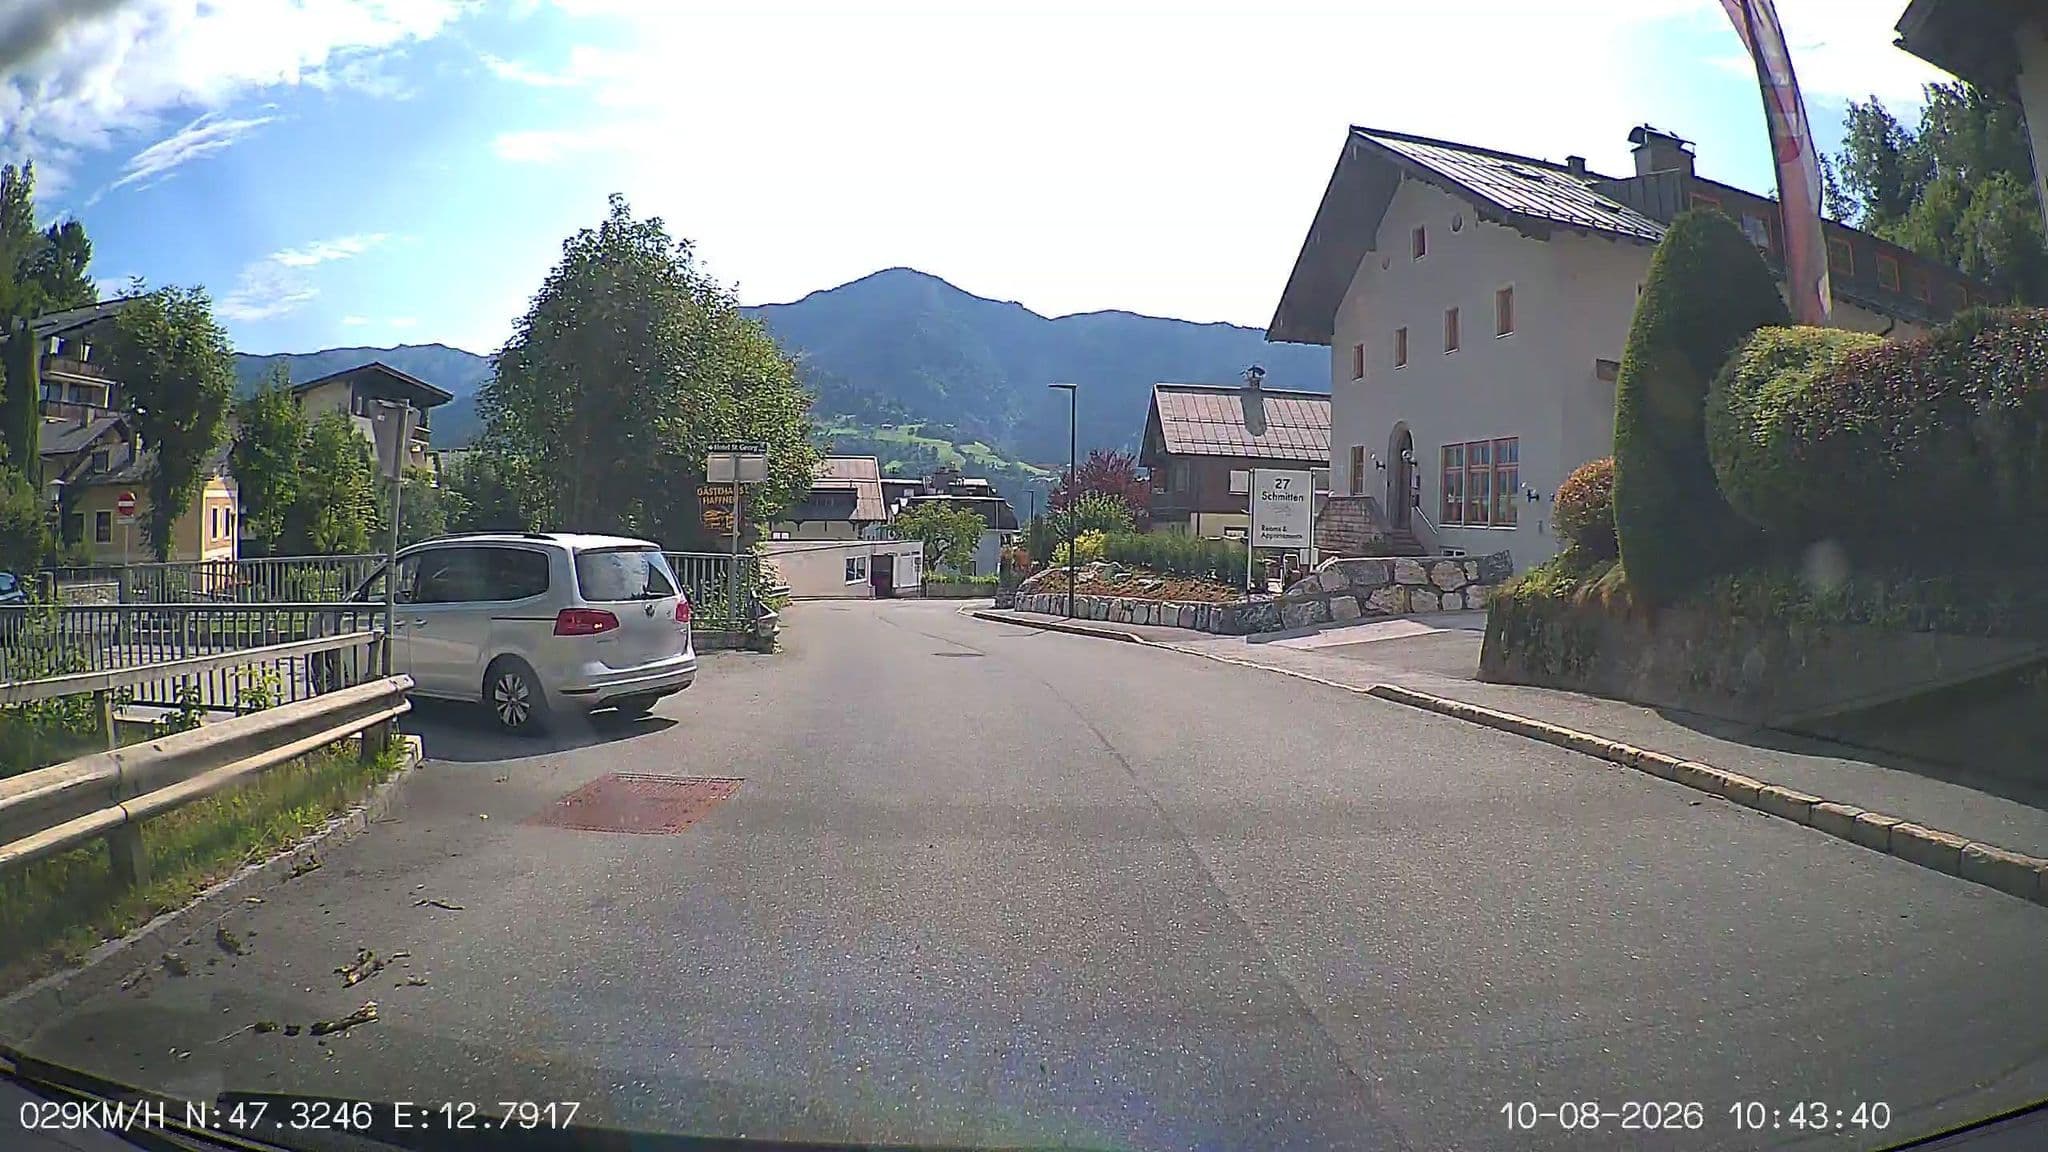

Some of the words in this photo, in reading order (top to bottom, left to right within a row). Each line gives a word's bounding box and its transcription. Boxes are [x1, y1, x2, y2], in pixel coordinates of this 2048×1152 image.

[1275, 478, 1290, 489] 27
[1261, 491, 1304, 502] Schmitten
[1261, 524, 1281, 532] Rooms
